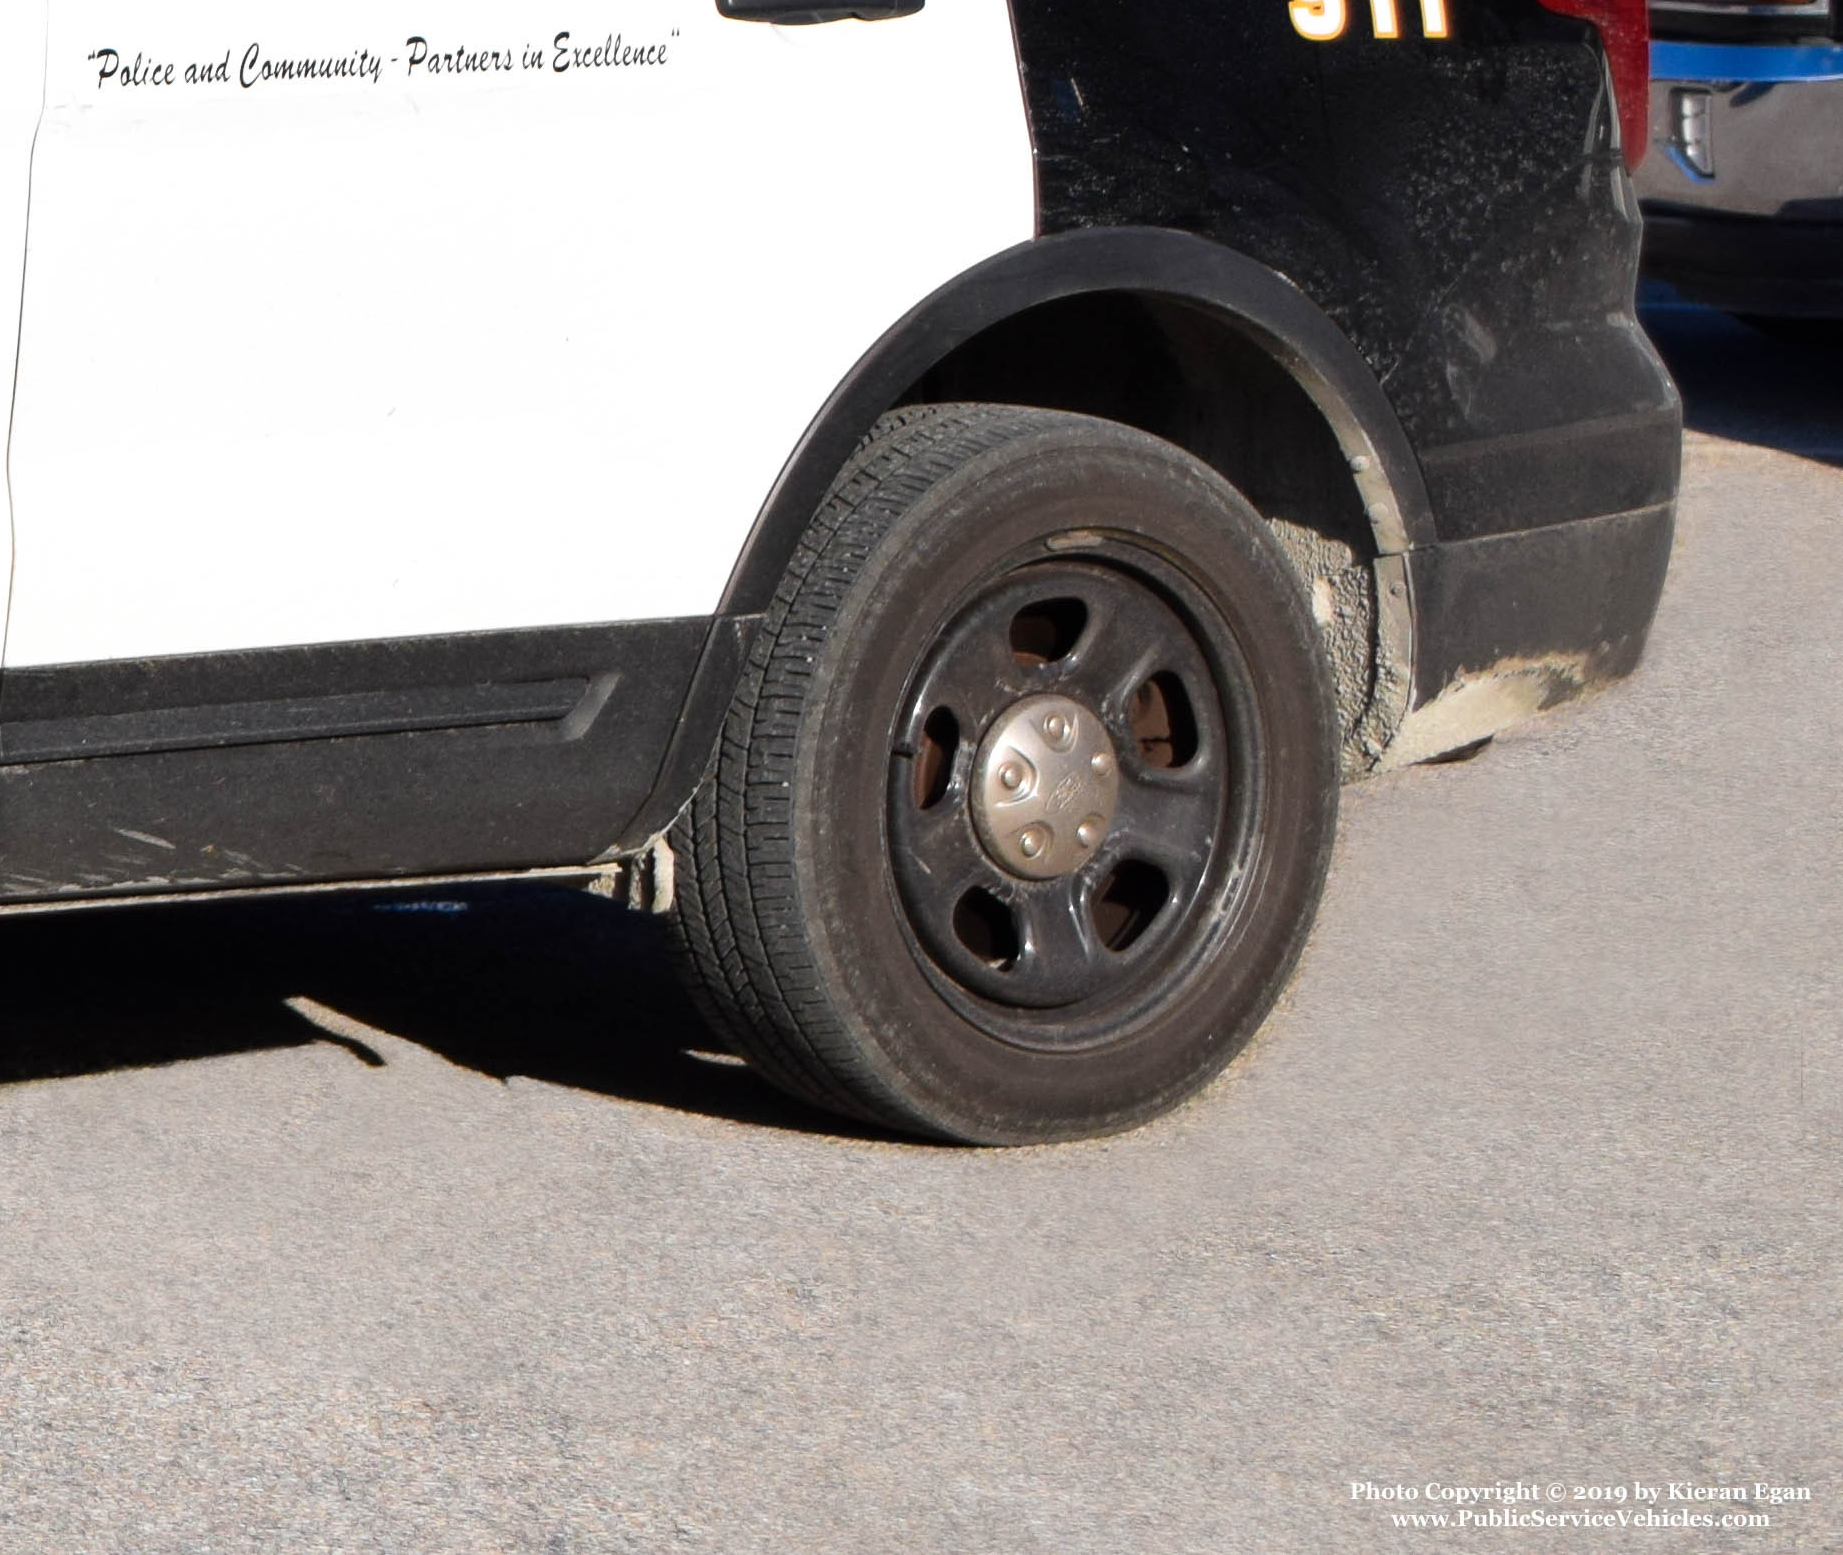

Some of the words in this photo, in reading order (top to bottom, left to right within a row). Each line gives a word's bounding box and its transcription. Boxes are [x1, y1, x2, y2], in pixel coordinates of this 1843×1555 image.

[184, 49, 231, 85] and
[239, 42, 383, 89] Community
[405, 36, 514, 77] Partners
[522, 43, 546, 70] in
